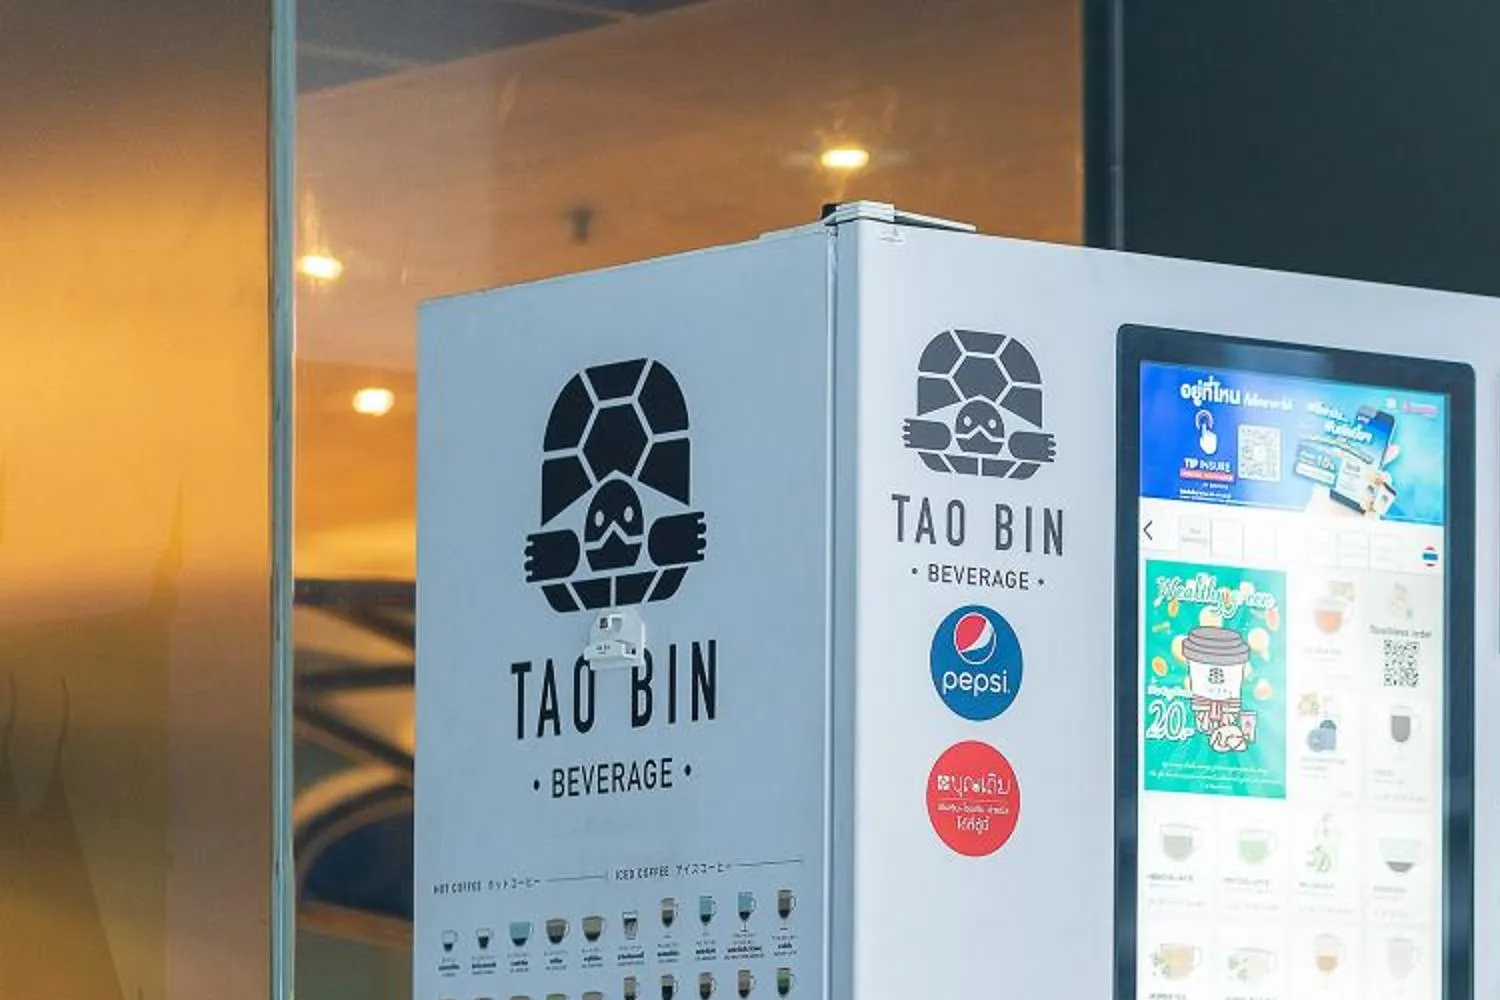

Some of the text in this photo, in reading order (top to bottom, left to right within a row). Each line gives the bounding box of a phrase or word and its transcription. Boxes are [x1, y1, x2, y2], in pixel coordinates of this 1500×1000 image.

[1184, 457, 1200, 469] TIP
[891, 494, 1064, 557] TAO BIN
[927, 564, 1030, 591] BEVERAGE
[511, 638, 718, 741] TAO BIN
[943, 669, 1007, 697] pepsi
[552, 757, 674, 798] BEVERAGE
[615, 868, 635, 881] ICED
[637, 865, 669, 879] COFFEE
